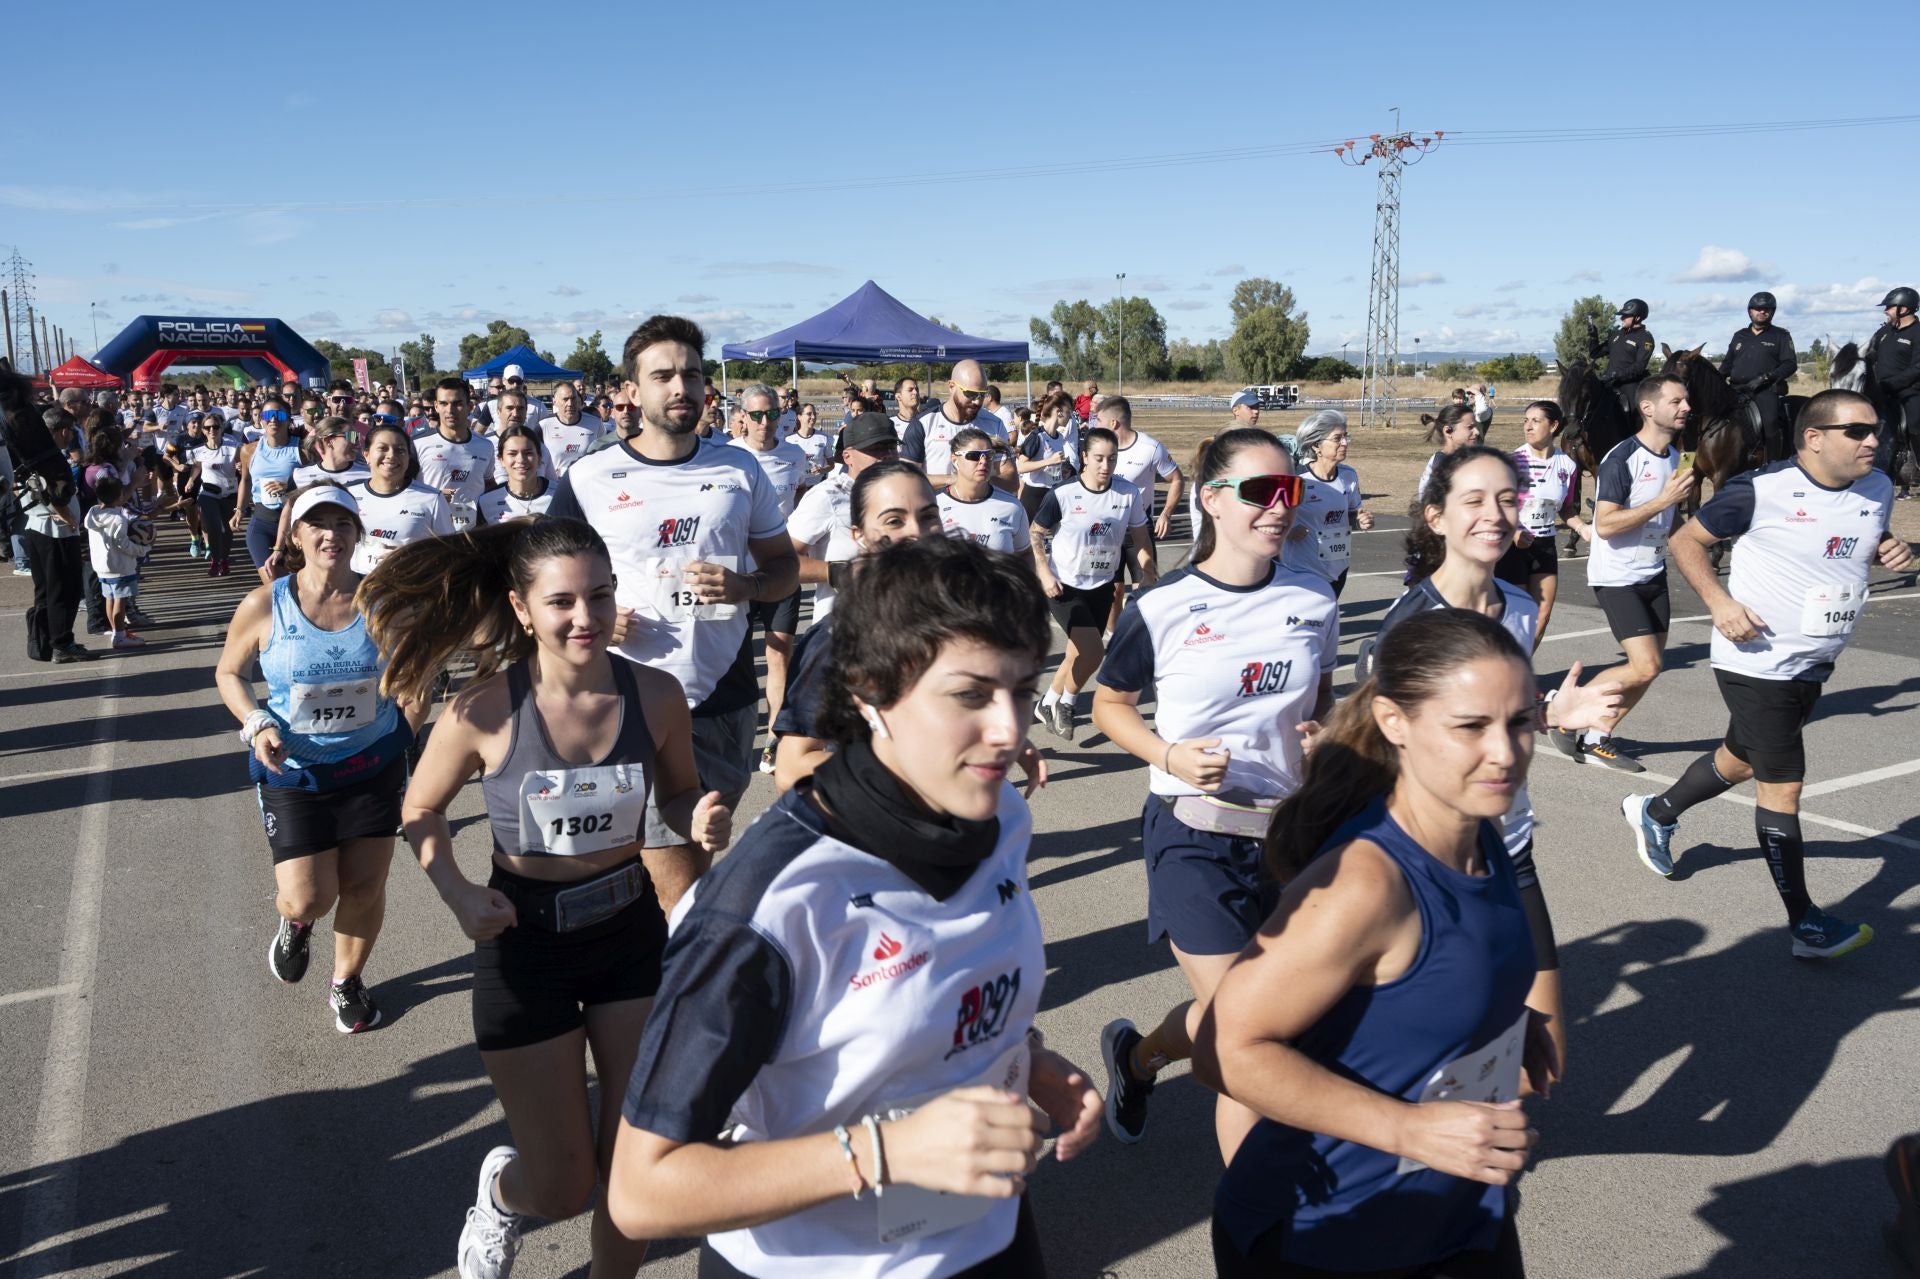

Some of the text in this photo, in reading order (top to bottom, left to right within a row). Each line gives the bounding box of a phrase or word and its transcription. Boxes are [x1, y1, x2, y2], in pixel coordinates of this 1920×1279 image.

[158, 322, 244, 333] POLICIA
[159, 332, 266, 344] NACIONAL
[608, 500, 644, 513] Santander
[1329, 543, 1346, 553] 1099
[1090, 561, 1110, 570] 1382
[1824, 610, 1856, 623] 1048
[1184, 633, 1226, 647] Santander
[293, 665, 379, 678] DE EXTREMADURA
[310, 660, 364, 670] CAJA RURAL
[312, 706, 356, 720] 1572
[551, 813, 613, 836] 1302
[849, 949, 930, 992] Santander
